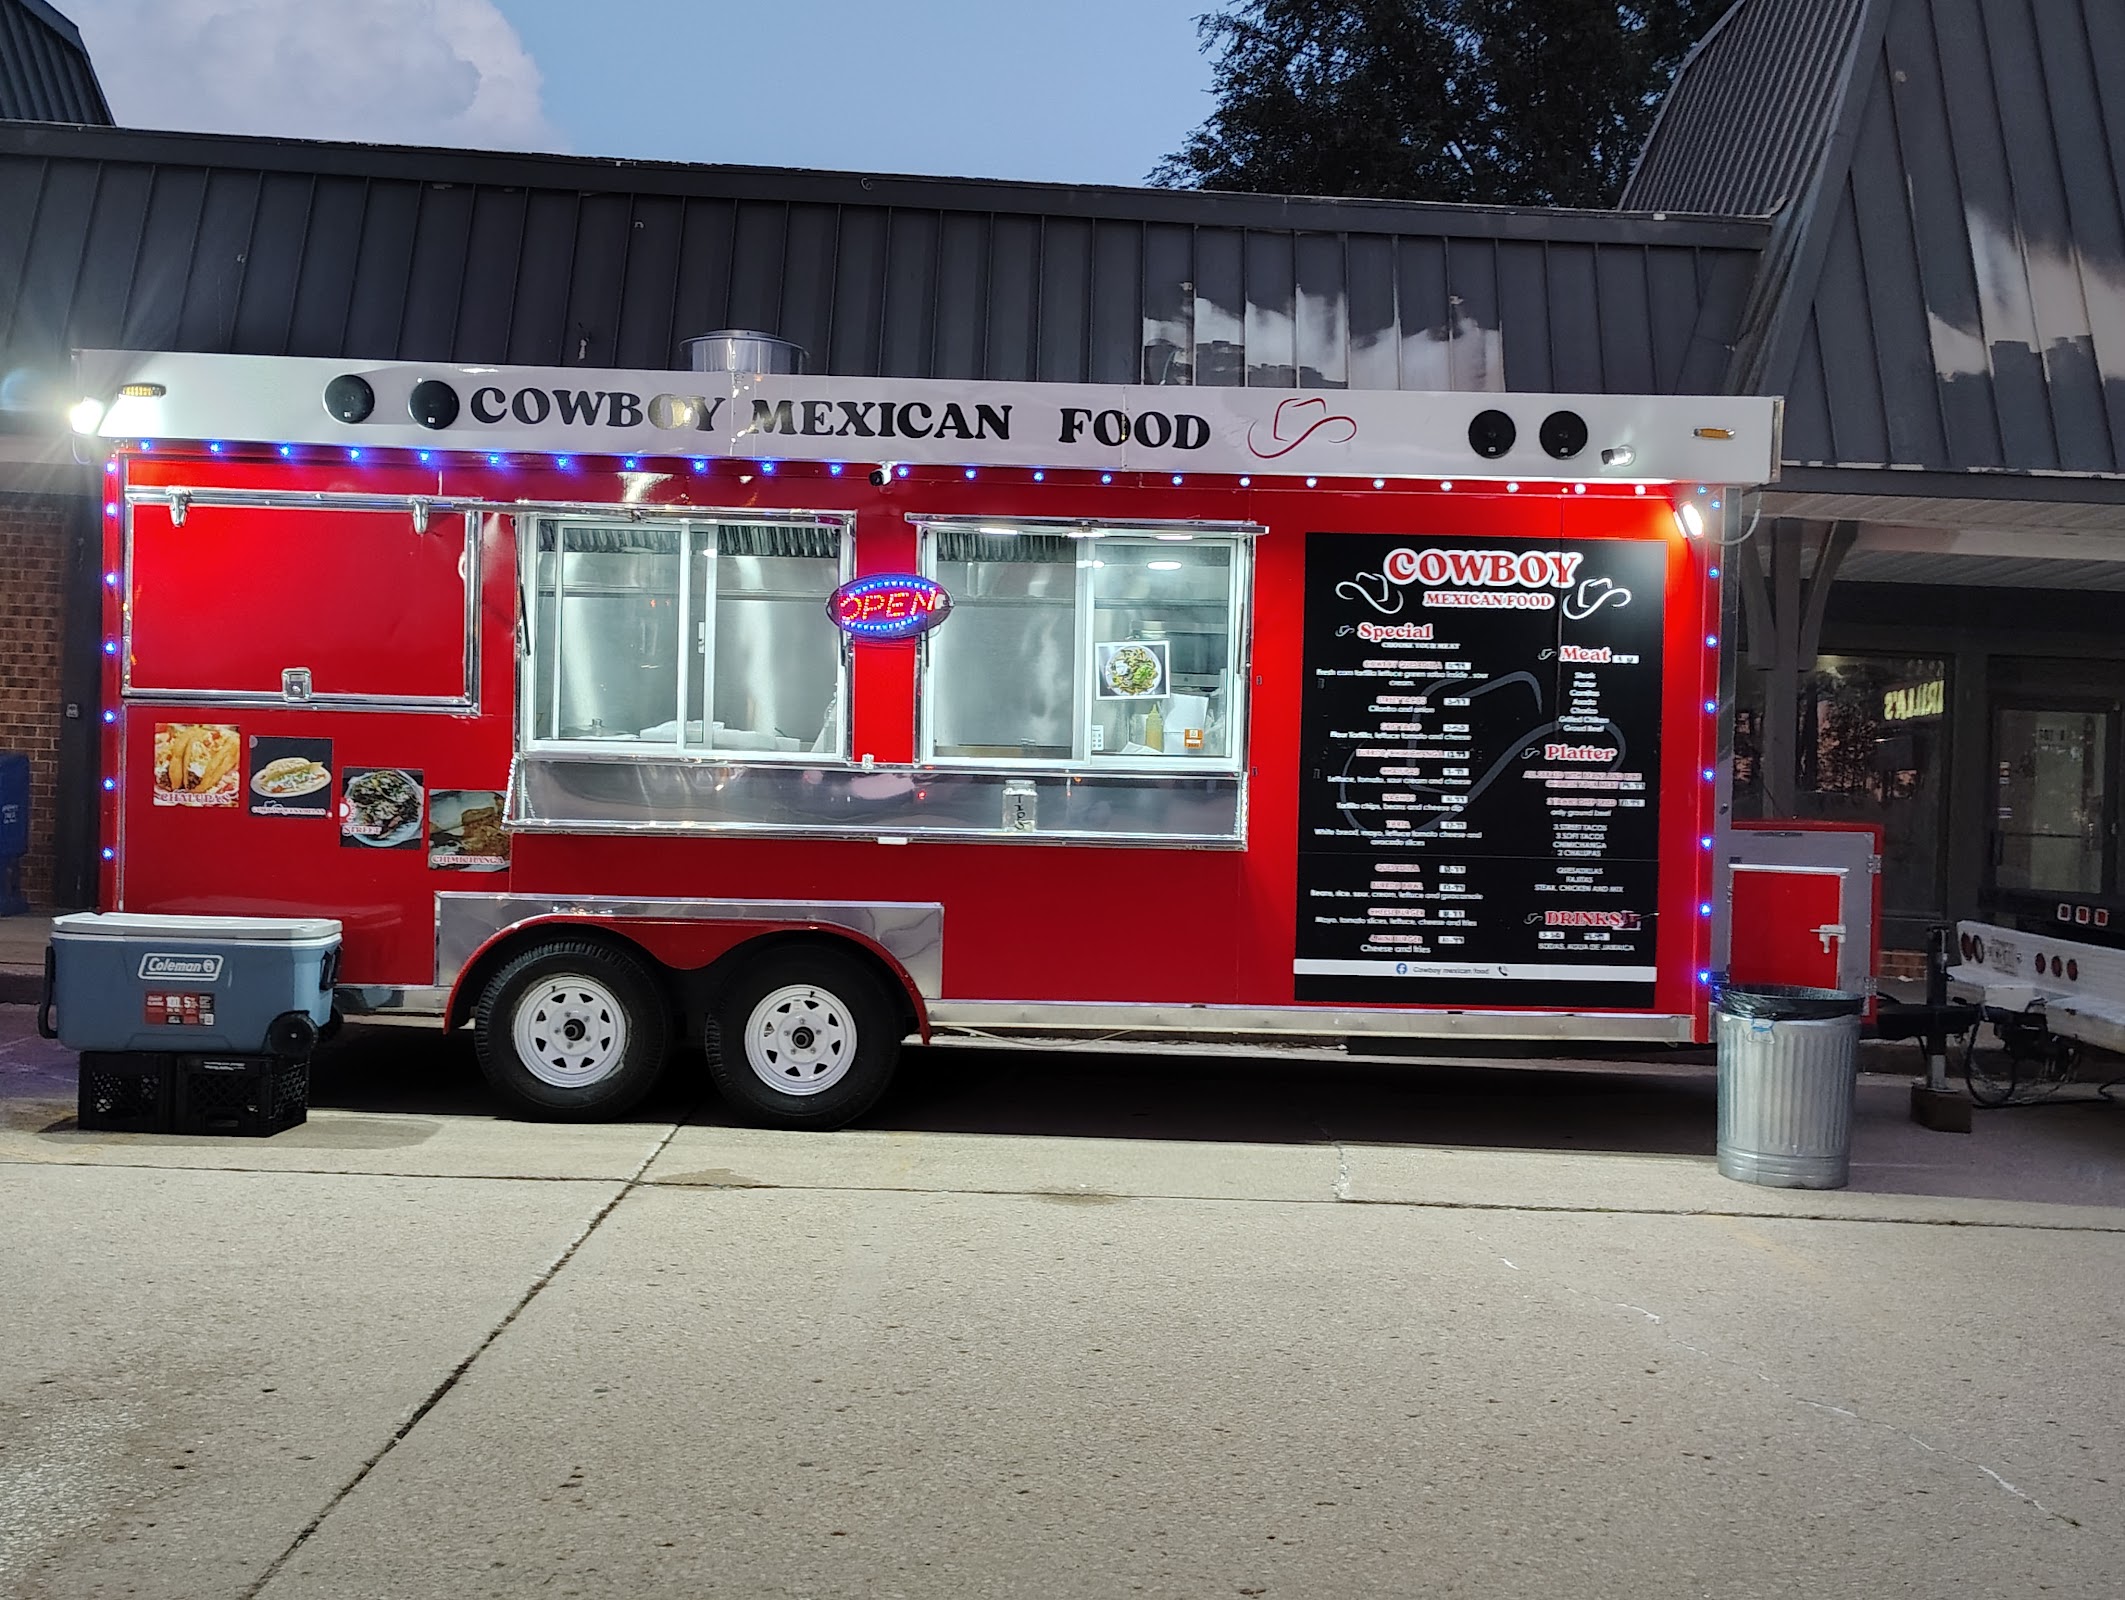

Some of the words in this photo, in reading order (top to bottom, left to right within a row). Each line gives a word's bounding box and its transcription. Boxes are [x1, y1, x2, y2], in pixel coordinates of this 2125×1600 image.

[470, 387, 727, 432] COWBOY
[751, 398, 1013, 440] MEXICAN
[1058, 407, 1211, 450] FOOD
[1386, 550, 1581, 587] COWBOY
[840, 588, 937, 621] OPEN
[1424, 592, 1507, 607] MEXICAN
[1507, 593, 1555, 609] FOOD
[1358, 623, 1434, 642] Special
[1559, 646, 1612, 663] Meat
[1544, 744, 1618, 761] Platter
[1545, 911, 1622, 926] DRINKS
[148, 957, 201, 972] Coleman
[1413, 966, 1441, 974] Cowboy
